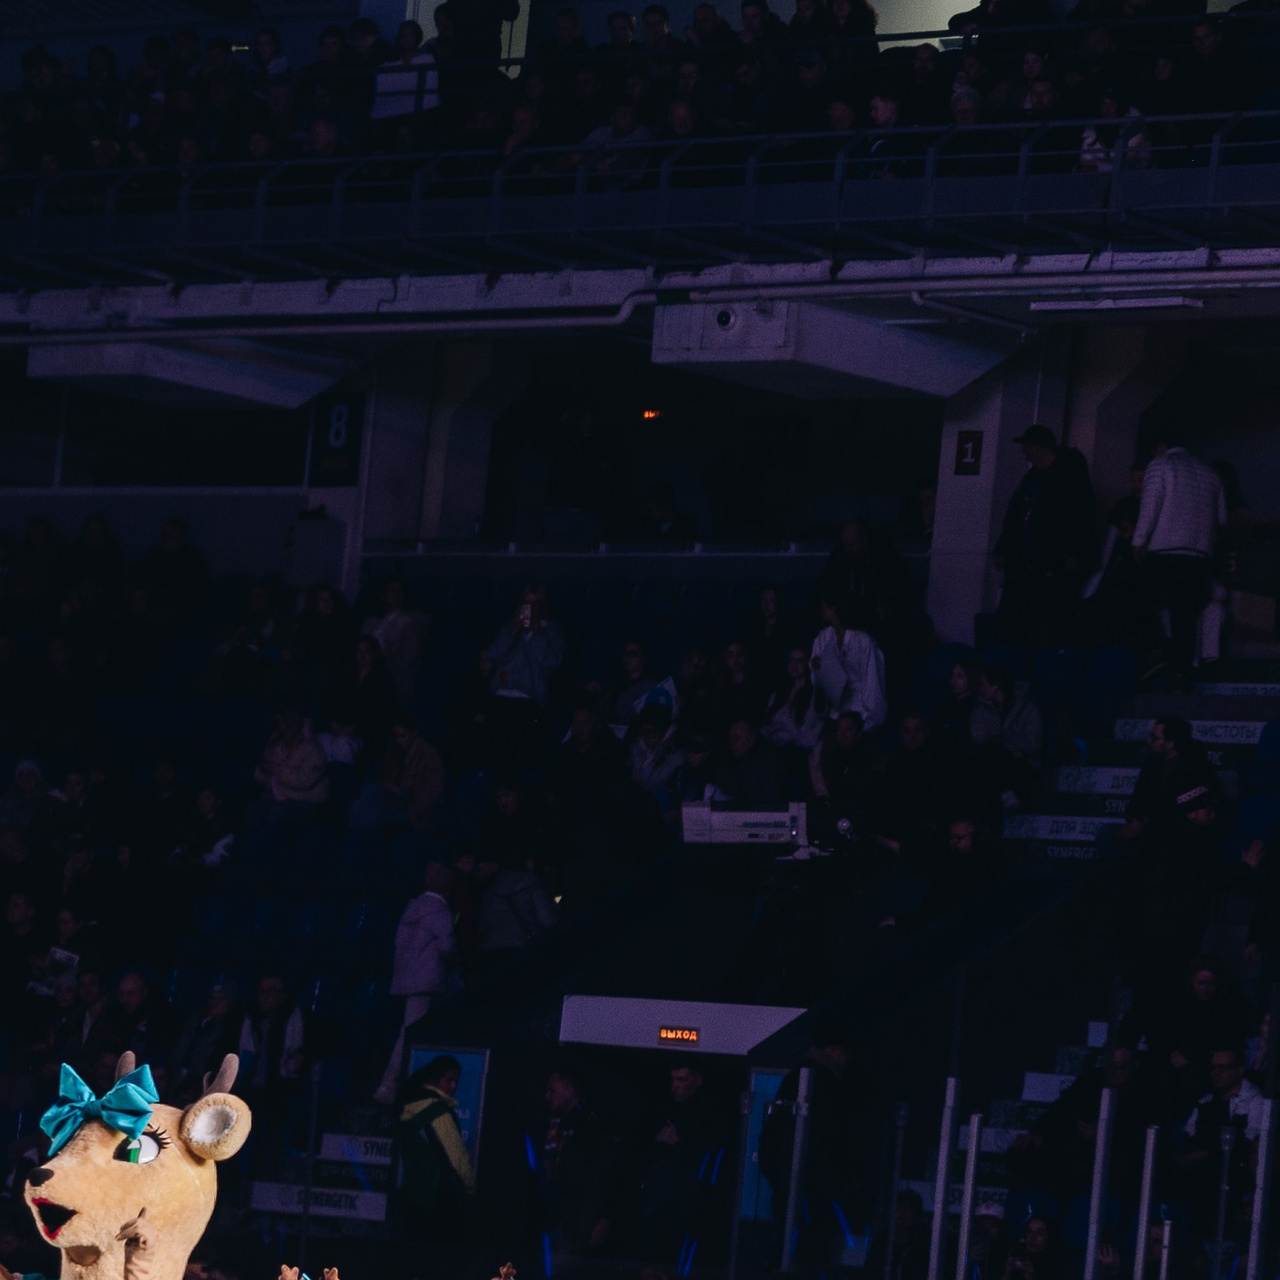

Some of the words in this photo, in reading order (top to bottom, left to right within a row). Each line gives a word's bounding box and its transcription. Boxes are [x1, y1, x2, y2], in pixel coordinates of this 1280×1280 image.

[328, 402, 348, 448] 8
[962, 441, 976, 464] 1
[660, 1029, 698, 1041] ВЫХОД
